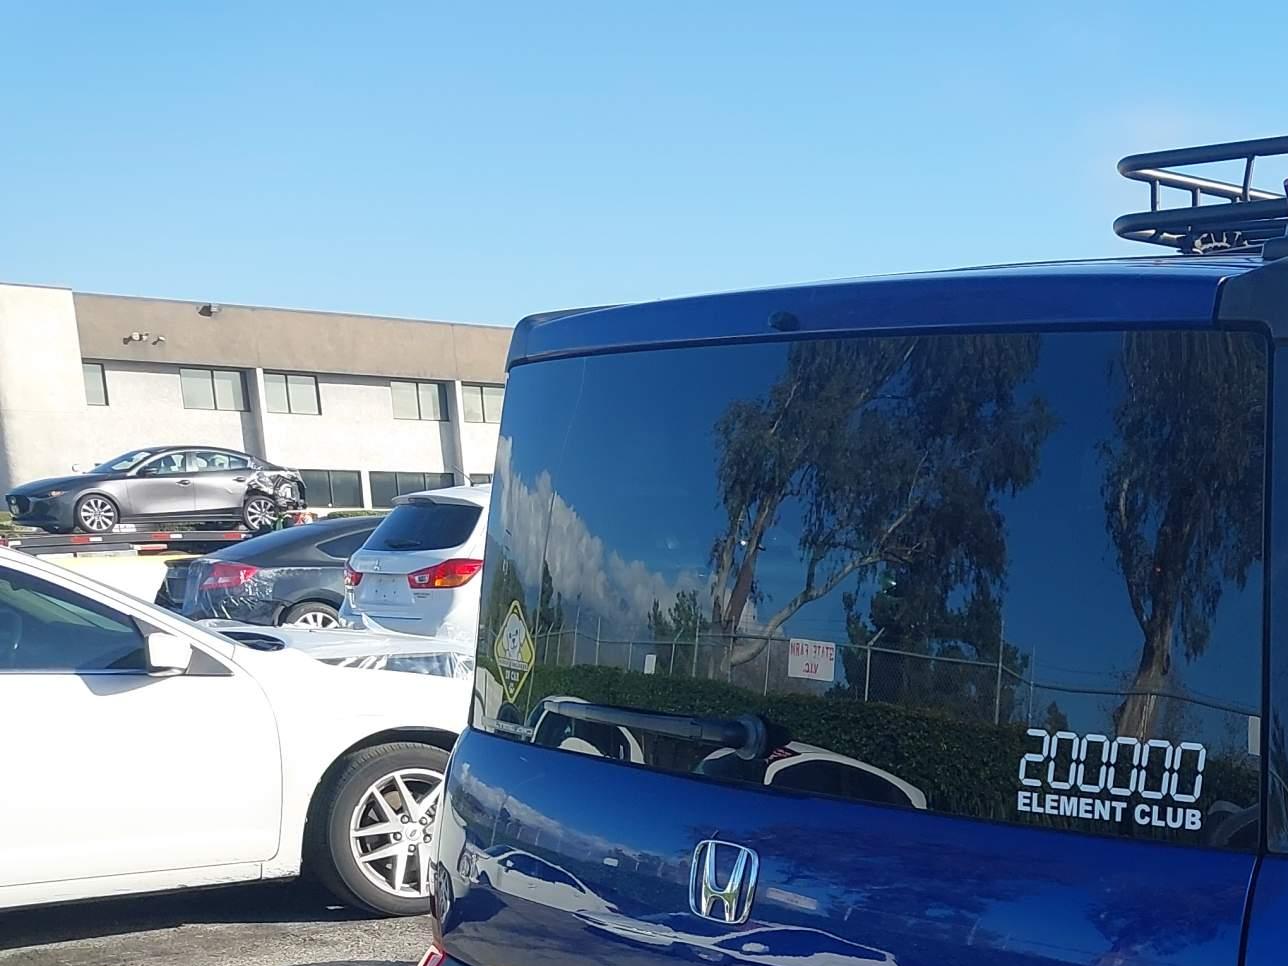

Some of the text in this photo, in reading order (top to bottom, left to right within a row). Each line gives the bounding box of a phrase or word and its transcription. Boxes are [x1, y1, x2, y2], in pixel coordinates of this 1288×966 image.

[1018, 728, 1207, 803] 200000
[1017, 791, 1202, 830] ELEMENT CLUB
